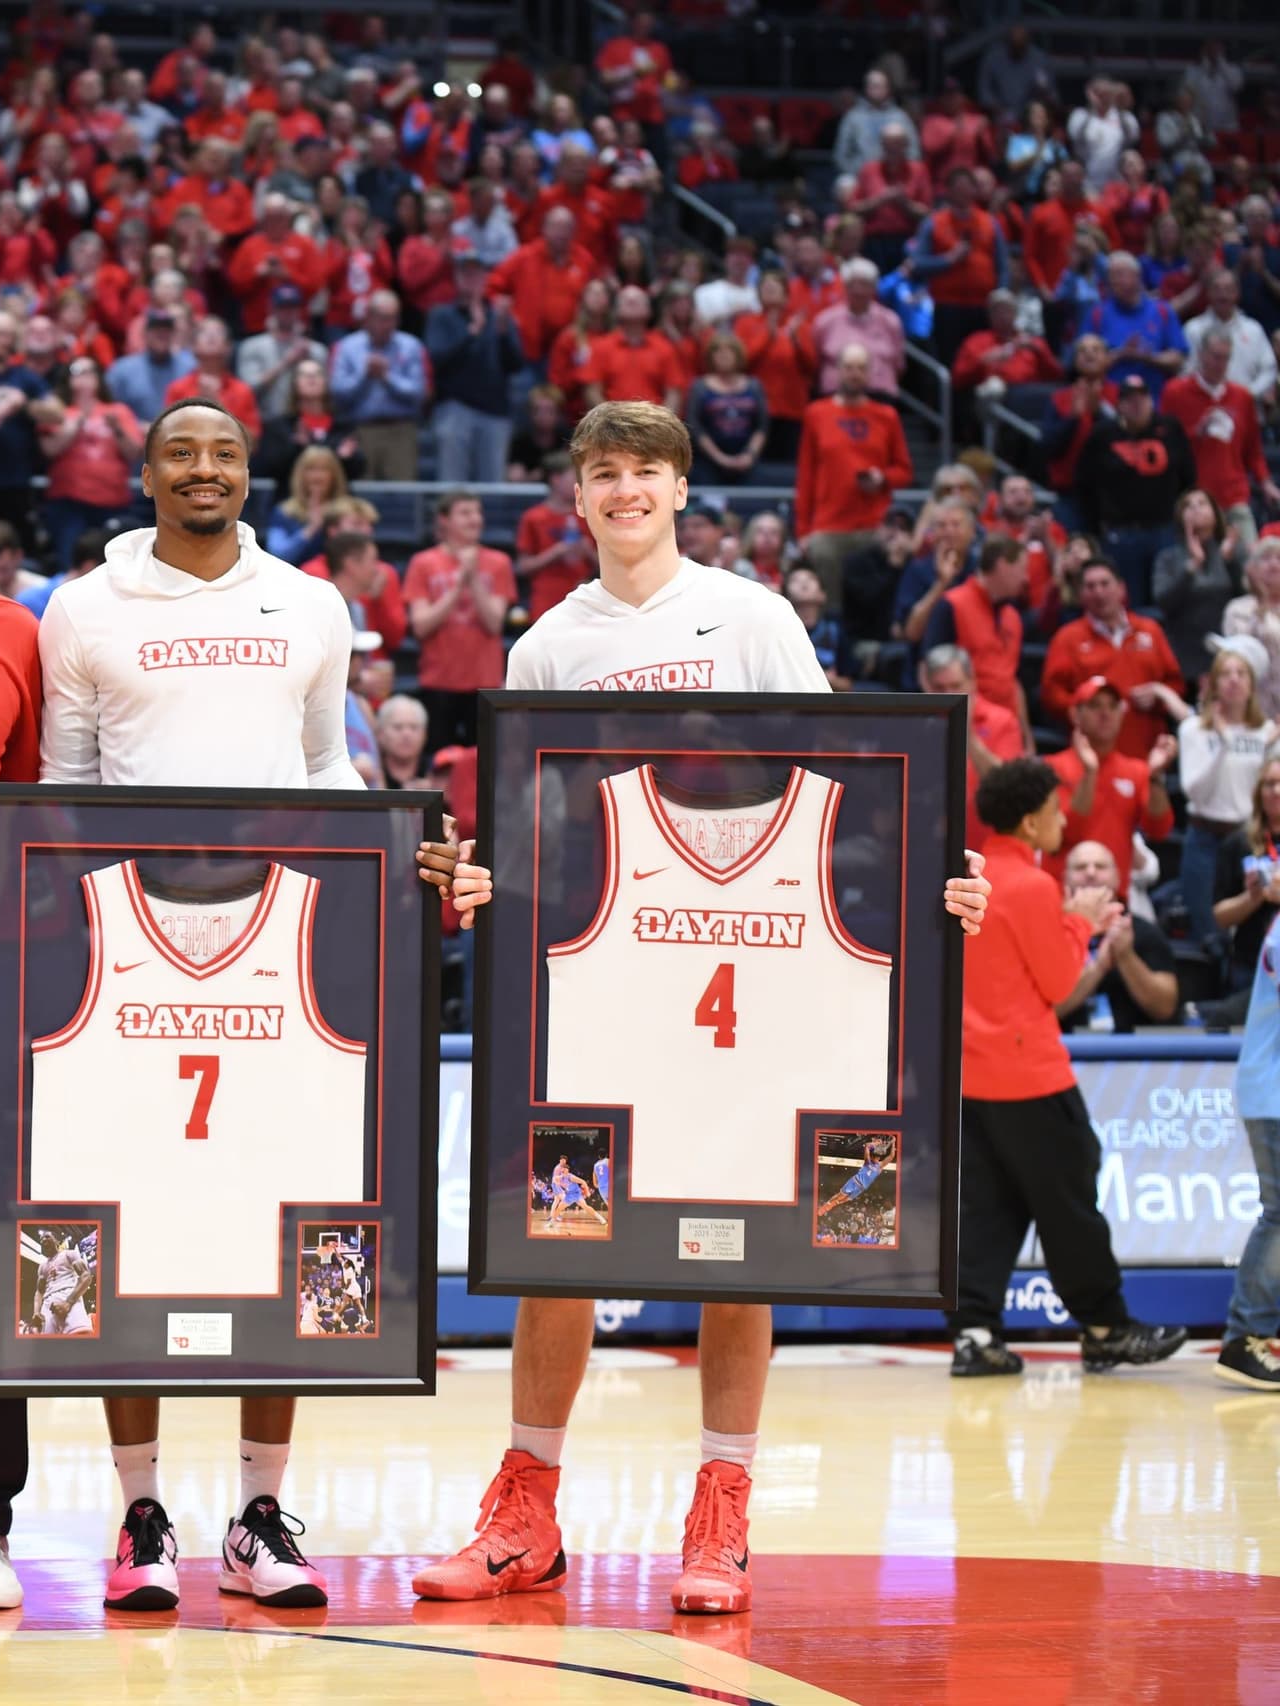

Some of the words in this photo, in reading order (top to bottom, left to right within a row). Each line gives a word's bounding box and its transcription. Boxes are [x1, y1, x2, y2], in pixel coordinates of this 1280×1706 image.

[138, 637, 289, 671] DAYTON
[632, 907, 805, 949] DAYTON
[115, 1003, 283, 1040] DAYTON
[694, 963, 737, 1048] 4
[178, 1055, 220, 1140] 7
[1149, 1087, 1234, 1118] OVER
[1091, 1118, 1189, 1149] YEARS
[1191, 1118, 1236, 1149] OF
